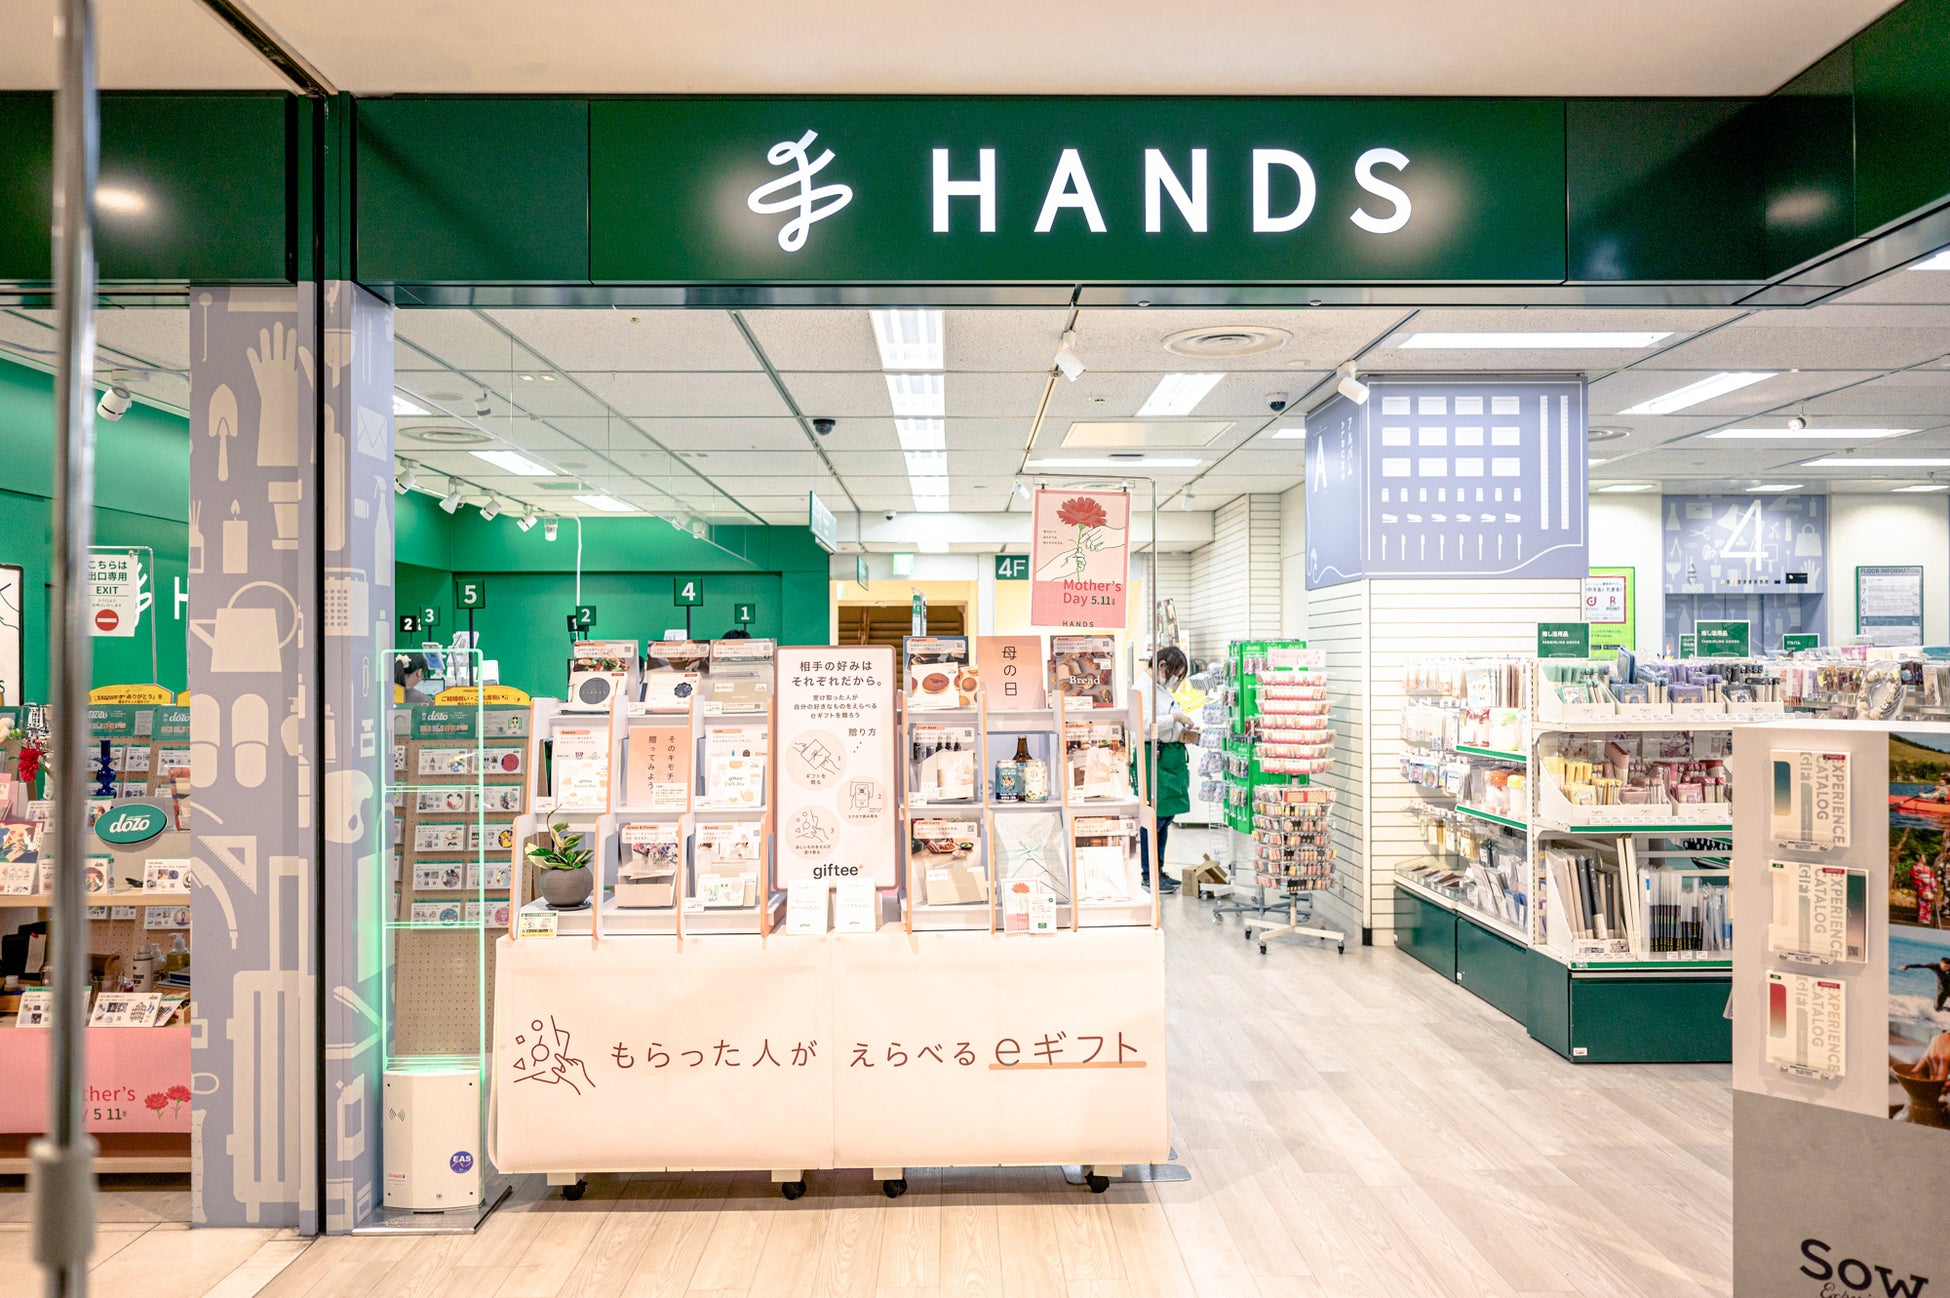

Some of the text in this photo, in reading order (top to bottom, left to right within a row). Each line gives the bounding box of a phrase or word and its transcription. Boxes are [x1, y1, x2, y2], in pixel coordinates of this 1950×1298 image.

[931, 147, 1413, 234] HANDS
[1720, 500, 1769, 571] 4
[998, 558, 1026, 577] 4F
[96, 586, 119, 595] EXIT
[681, 582, 696, 601] 4
[1063, 579, 1122, 592] Mother's
[464, 585, 477, 604] 5
[1063, 592, 1088, 606] Day
[425, 608, 434, 623] 3
[580, 608, 591, 623] 2
[740, 606, 750, 620] 1
[404, 617, 413, 631] 2
[1062, 620, 1095, 628] HANDS
[800, 661, 872, 672] 相手の好みは
[1002, 646, 1017, 696] 母の日
[792, 676, 882, 687] それぞれだから。
[1070, 676, 1101, 685] Bread
[848, 727, 877, 737] 贈り方
[813, 864, 859, 880] giftee
[611, 1039, 818, 1067] もらった人が
